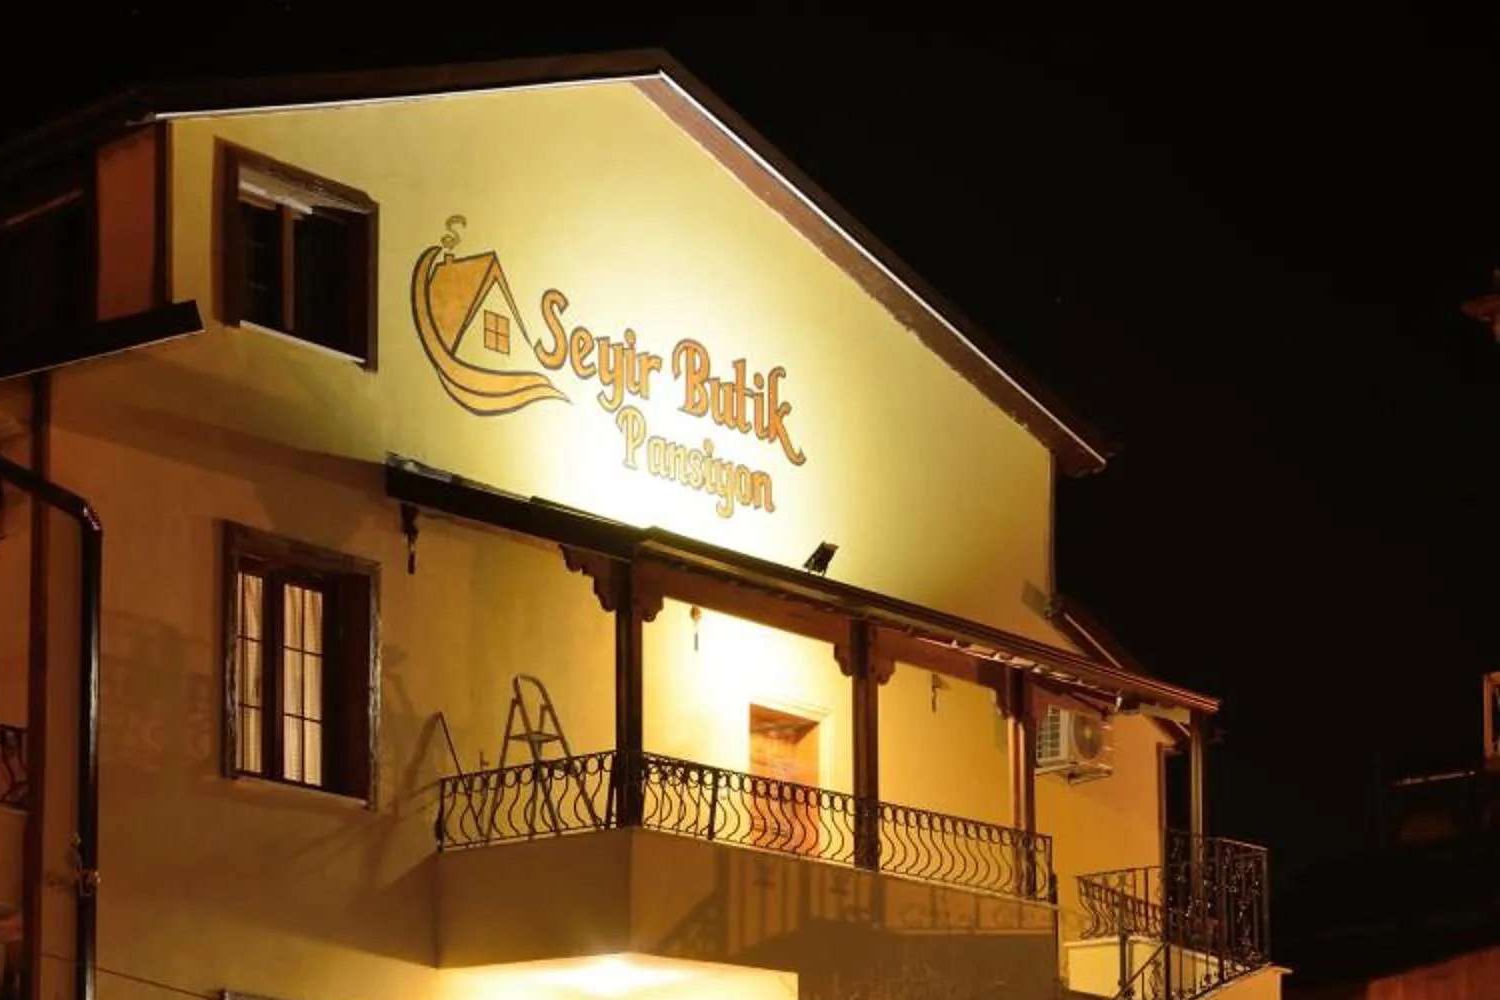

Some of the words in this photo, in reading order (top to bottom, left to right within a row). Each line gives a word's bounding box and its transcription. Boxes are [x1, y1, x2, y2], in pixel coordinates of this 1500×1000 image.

[533, 288, 662, 412] Seyir
[671, 338, 807, 465] Butik
[615, 405, 775, 519] Pansiyon
